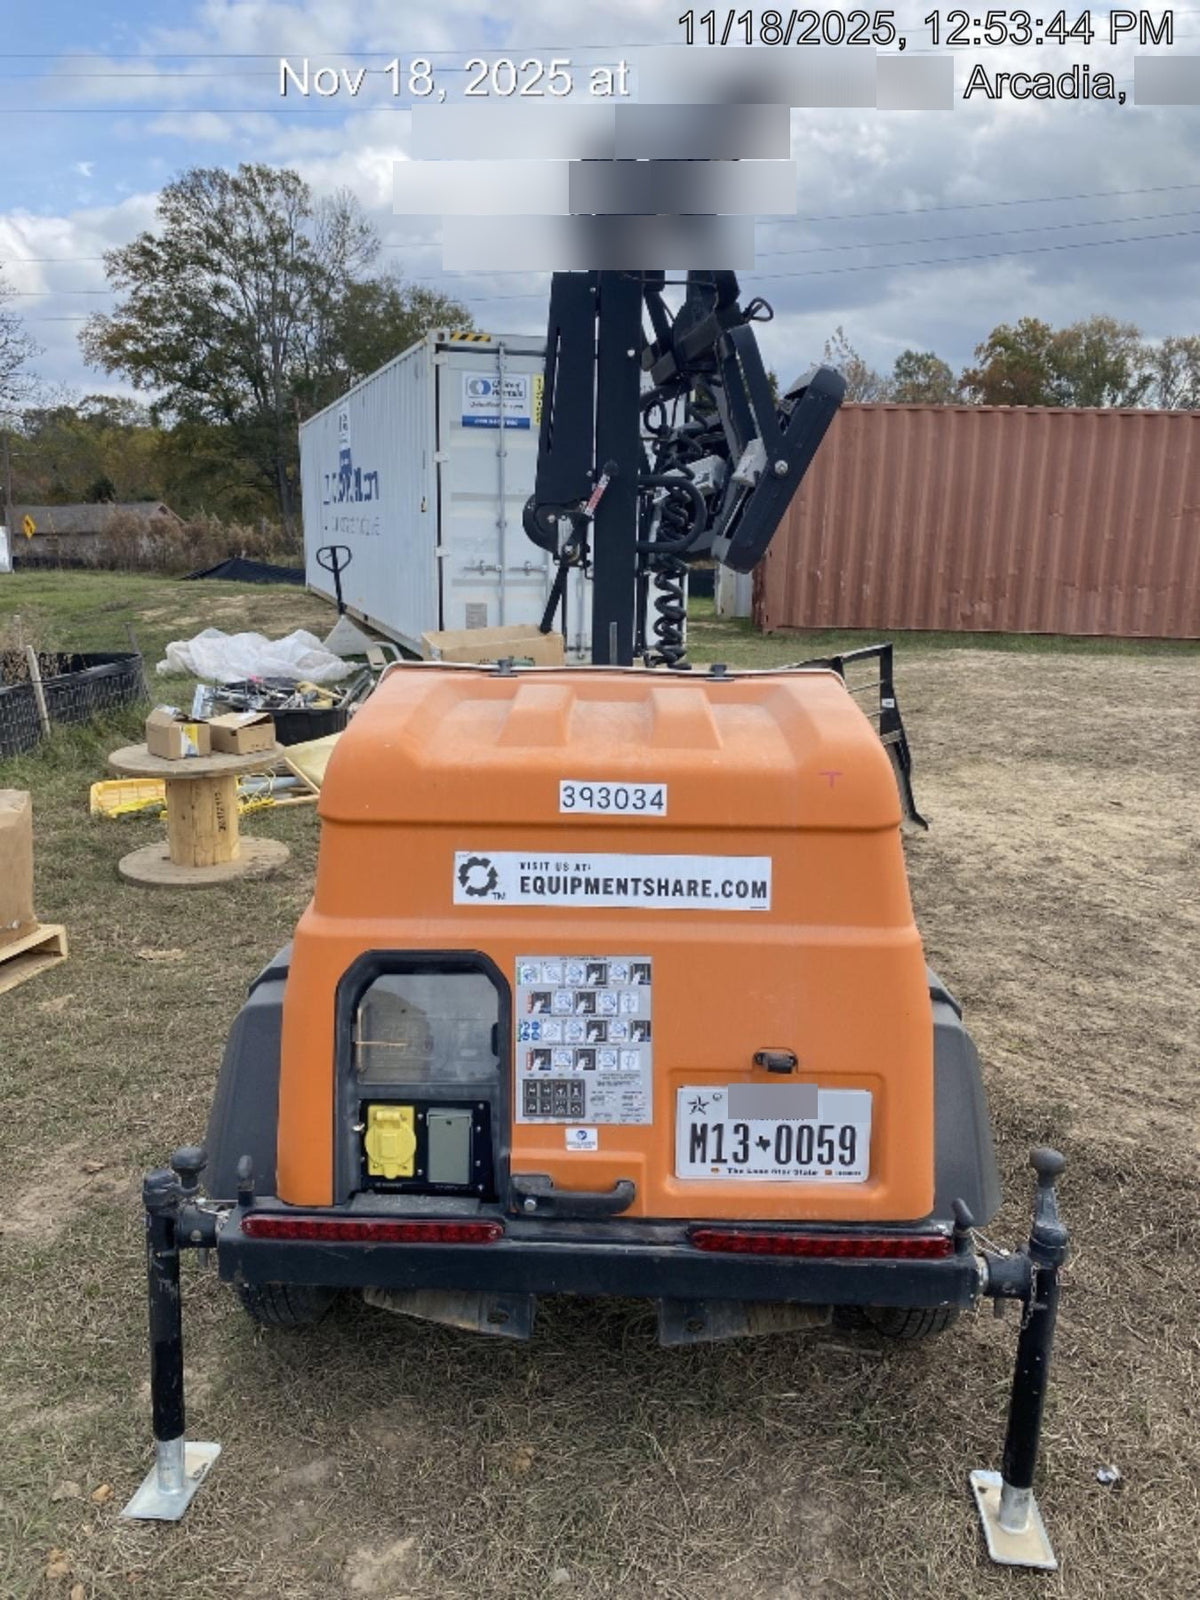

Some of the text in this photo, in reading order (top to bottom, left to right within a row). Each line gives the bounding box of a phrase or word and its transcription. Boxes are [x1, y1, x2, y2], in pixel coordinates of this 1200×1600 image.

[562, 785, 665, 810] 393034
[519, 861, 550, 871] VISIT
[555, 862, 570, 872] US
[520, 875, 768, 900] EQUIPMENTSHARE.COM
[689, 1122, 857, 1166] M13 0059
